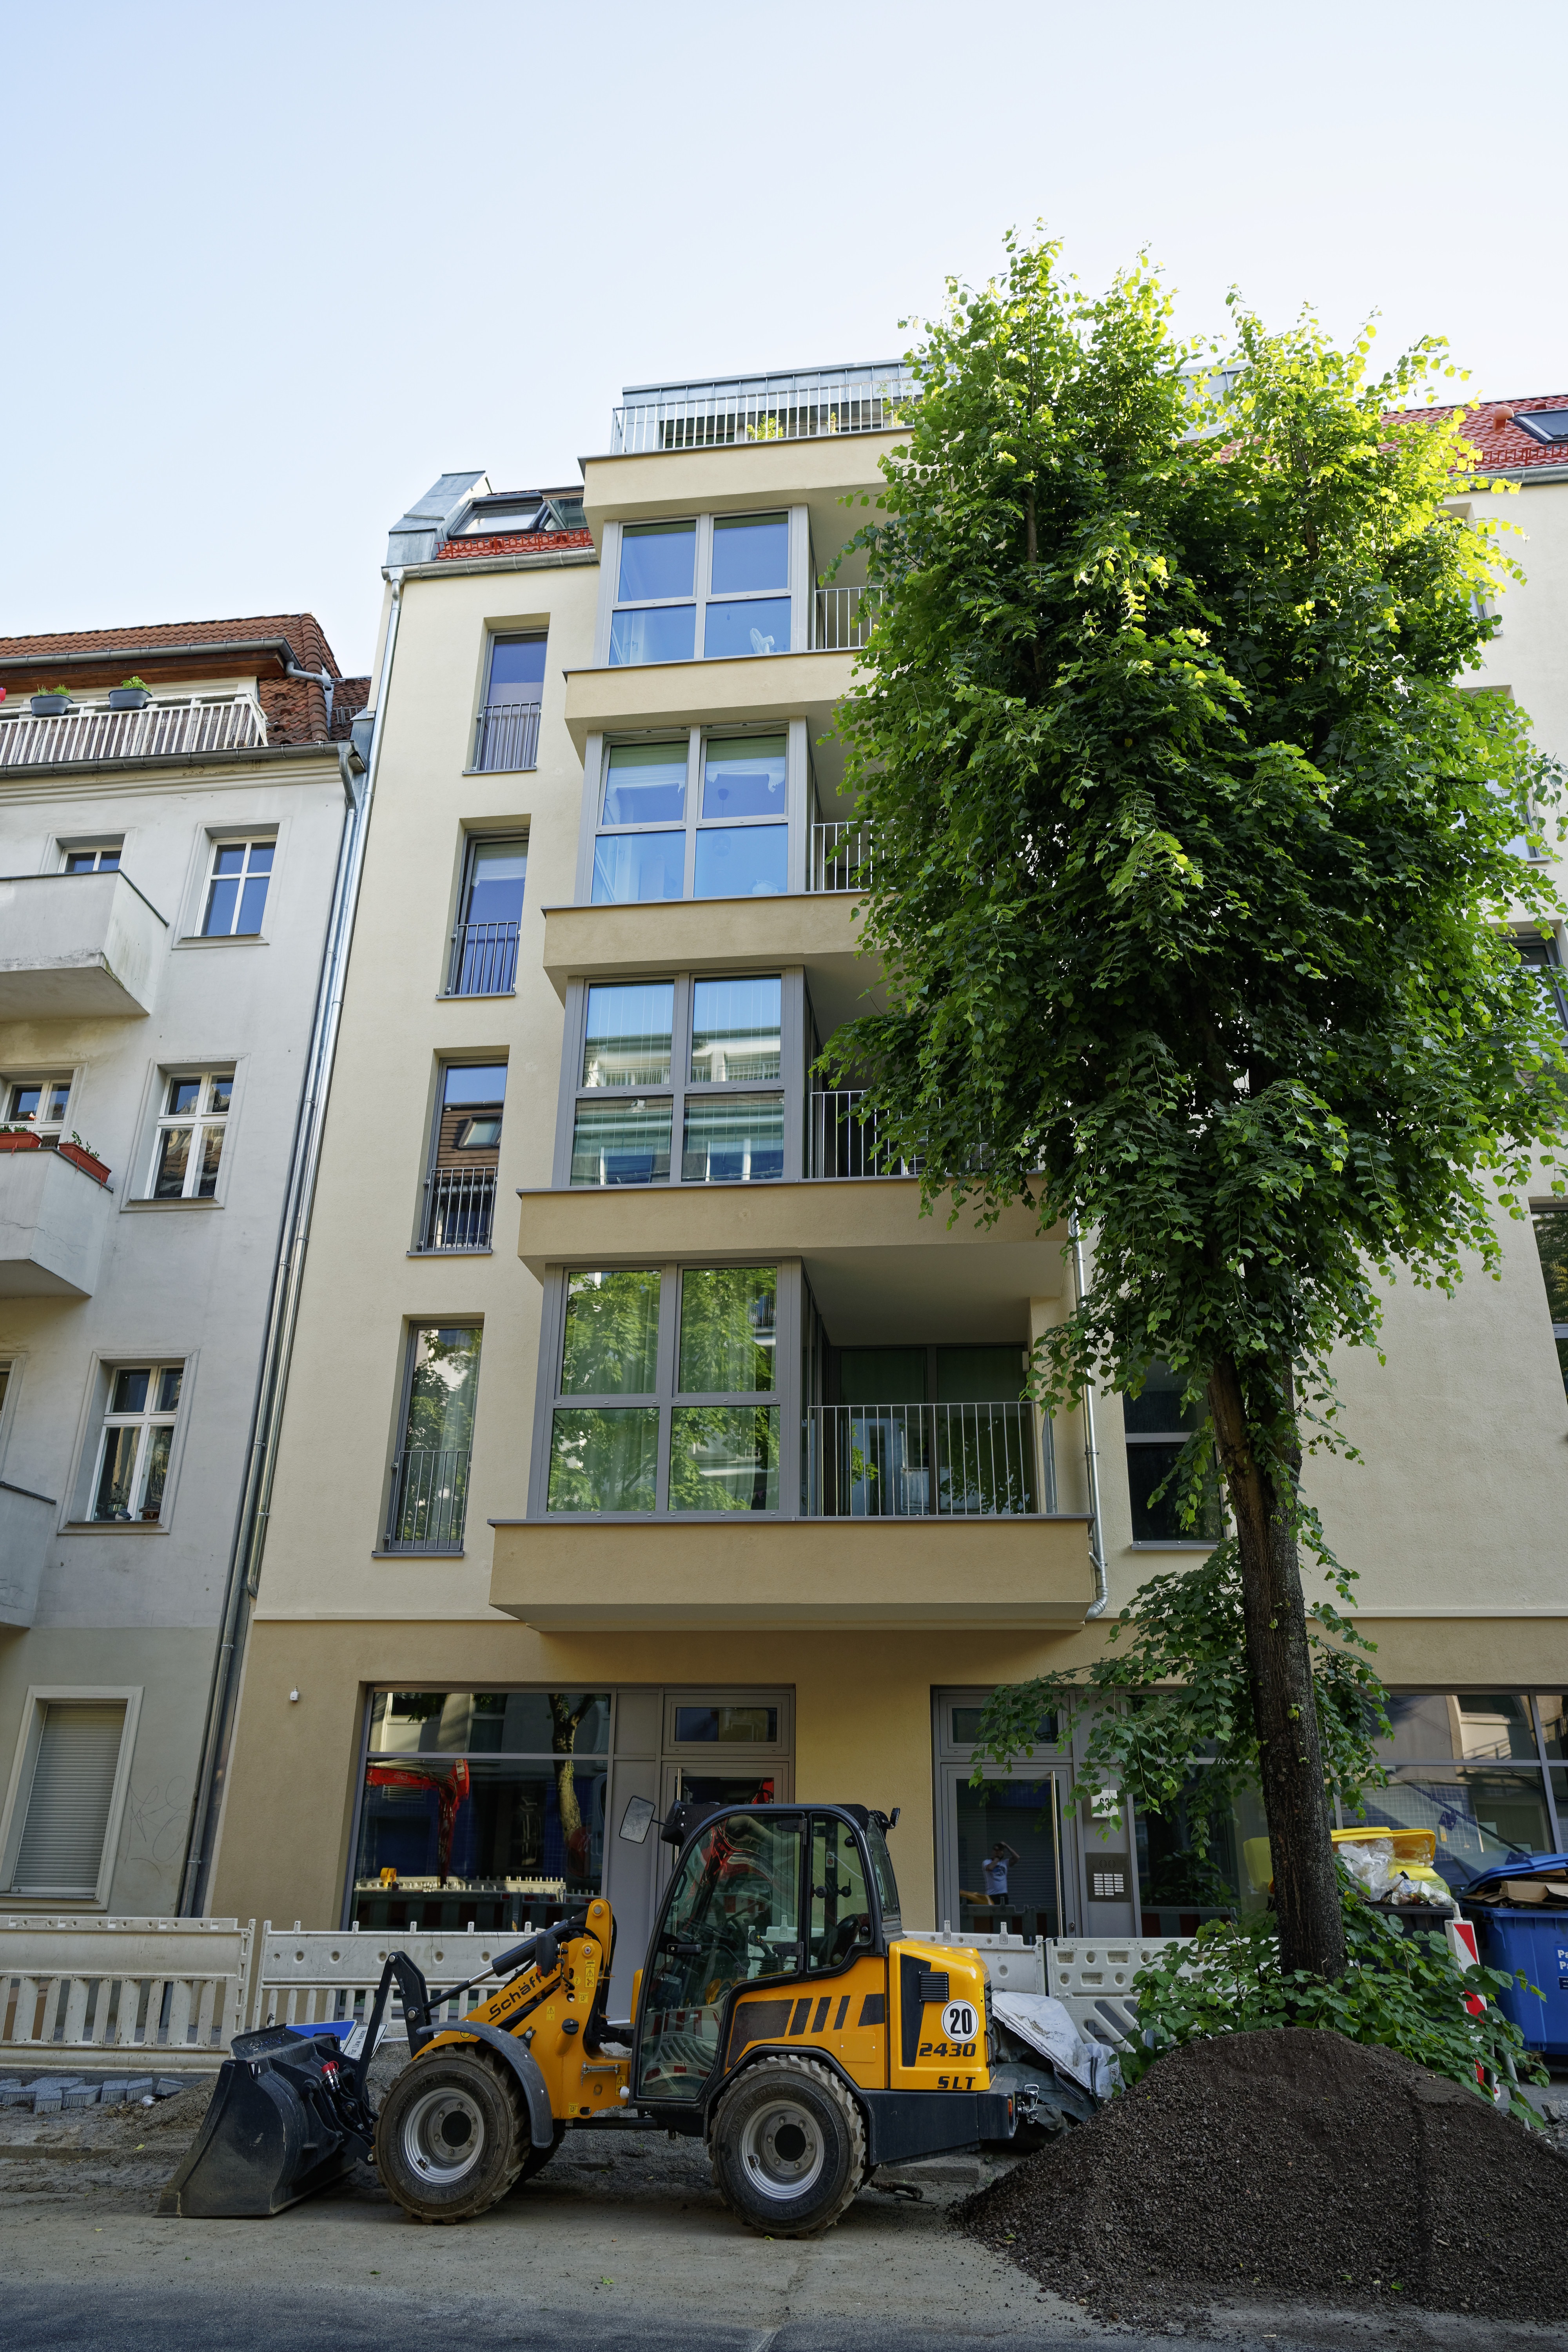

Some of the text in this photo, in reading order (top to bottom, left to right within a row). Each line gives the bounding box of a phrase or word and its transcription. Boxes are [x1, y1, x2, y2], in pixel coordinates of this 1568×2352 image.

[488, 1967, 557, 2022] Schäff
[950, 2008, 973, 2034] 20
[919, 2043, 976, 2057] 2430
[937, 2076, 976, 2090] SLT
